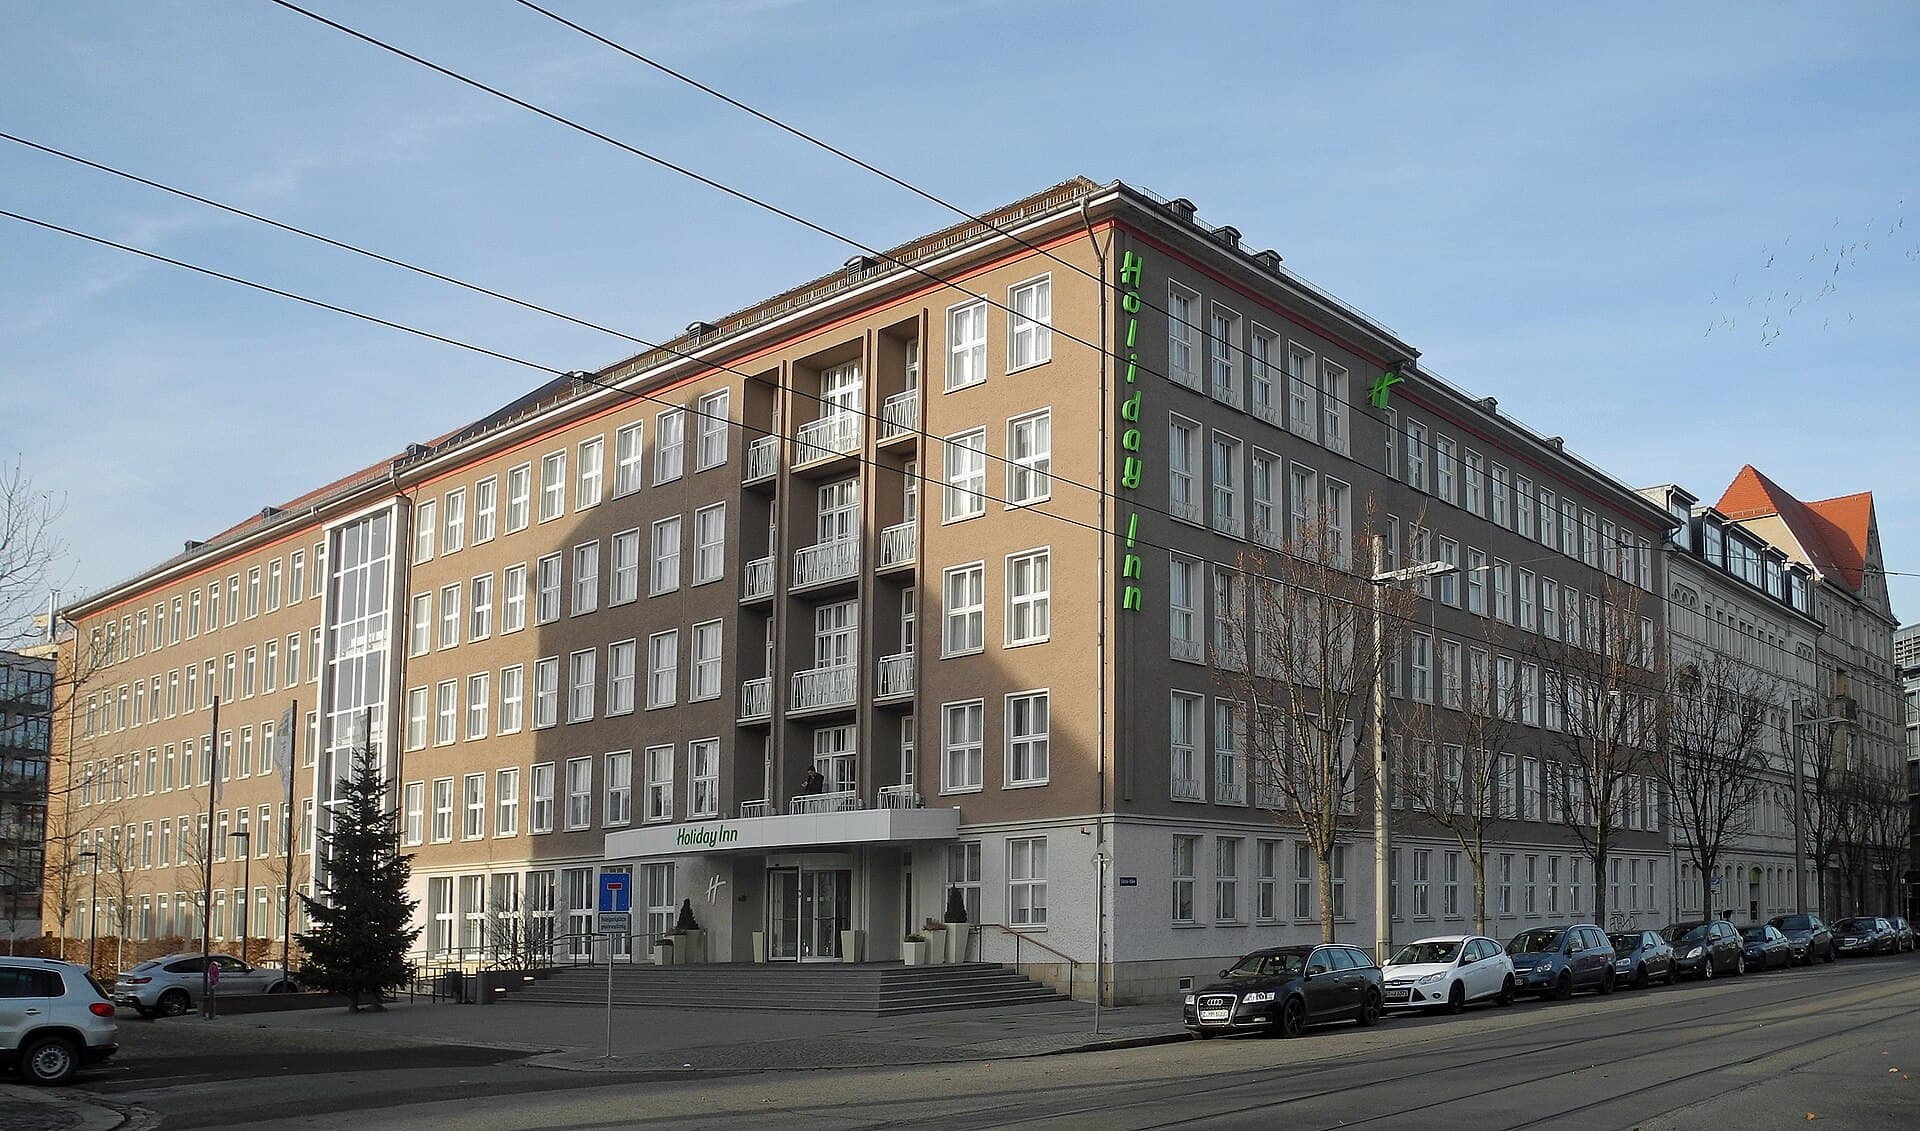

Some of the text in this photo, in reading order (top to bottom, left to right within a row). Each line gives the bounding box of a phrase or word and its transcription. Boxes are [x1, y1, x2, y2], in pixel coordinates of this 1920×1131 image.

[1120, 250, 1142, 612] Holiday Inn
[677, 824, 738, 848] Holiday Inn
